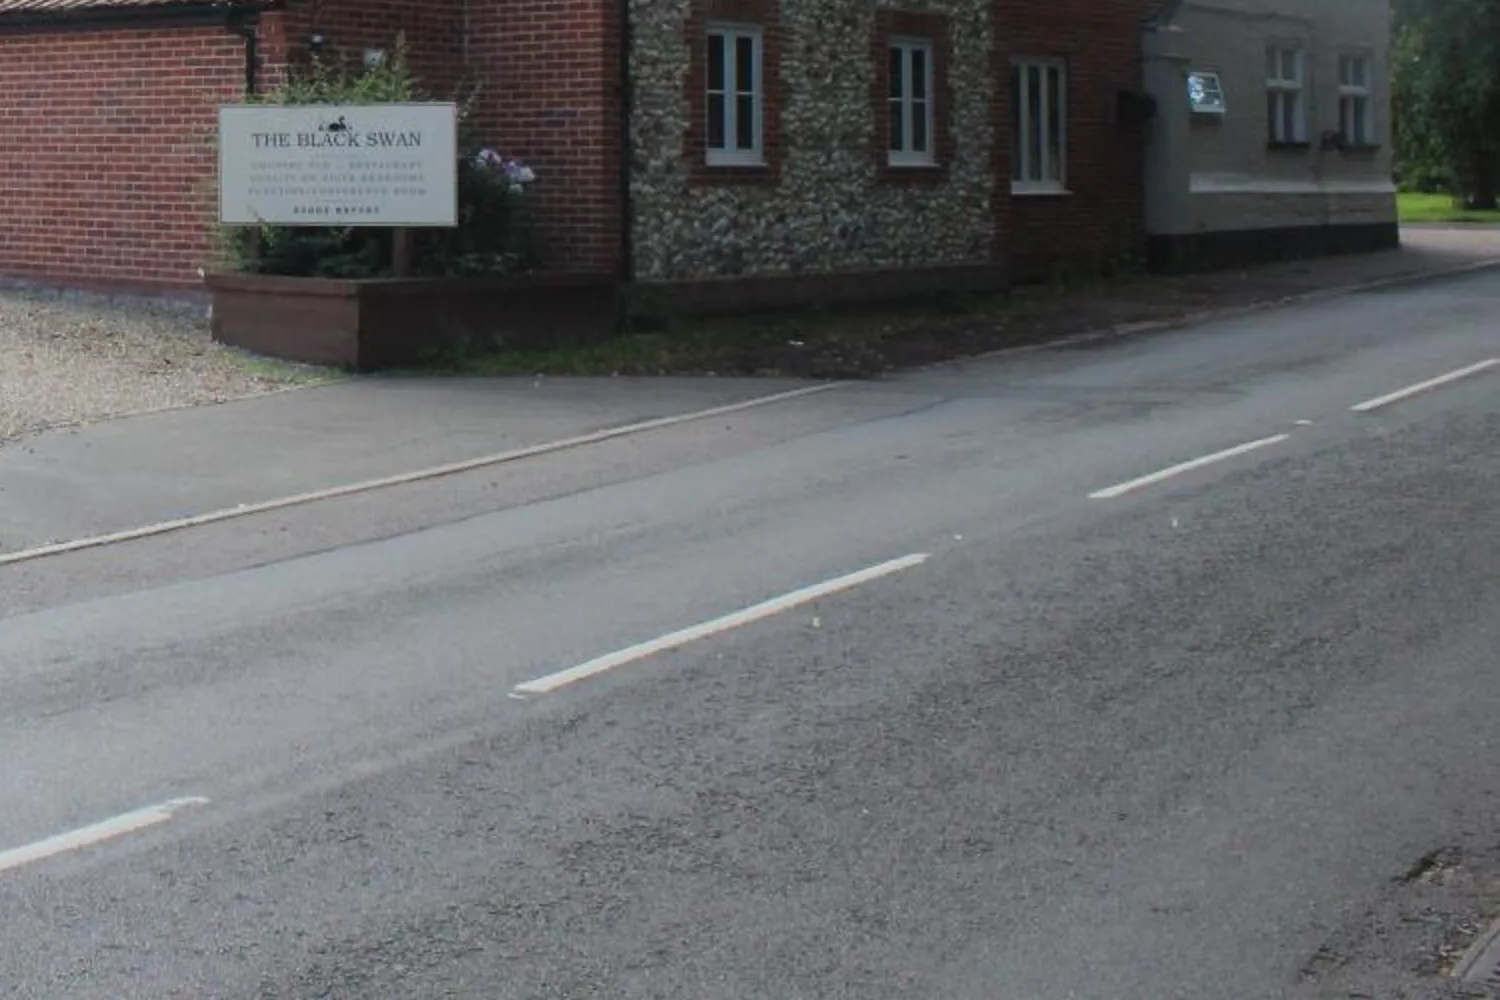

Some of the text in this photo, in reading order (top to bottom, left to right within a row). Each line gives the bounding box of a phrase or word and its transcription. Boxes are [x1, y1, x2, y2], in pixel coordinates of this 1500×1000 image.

[251, 131, 422, 148] THE BLACK SWAN
